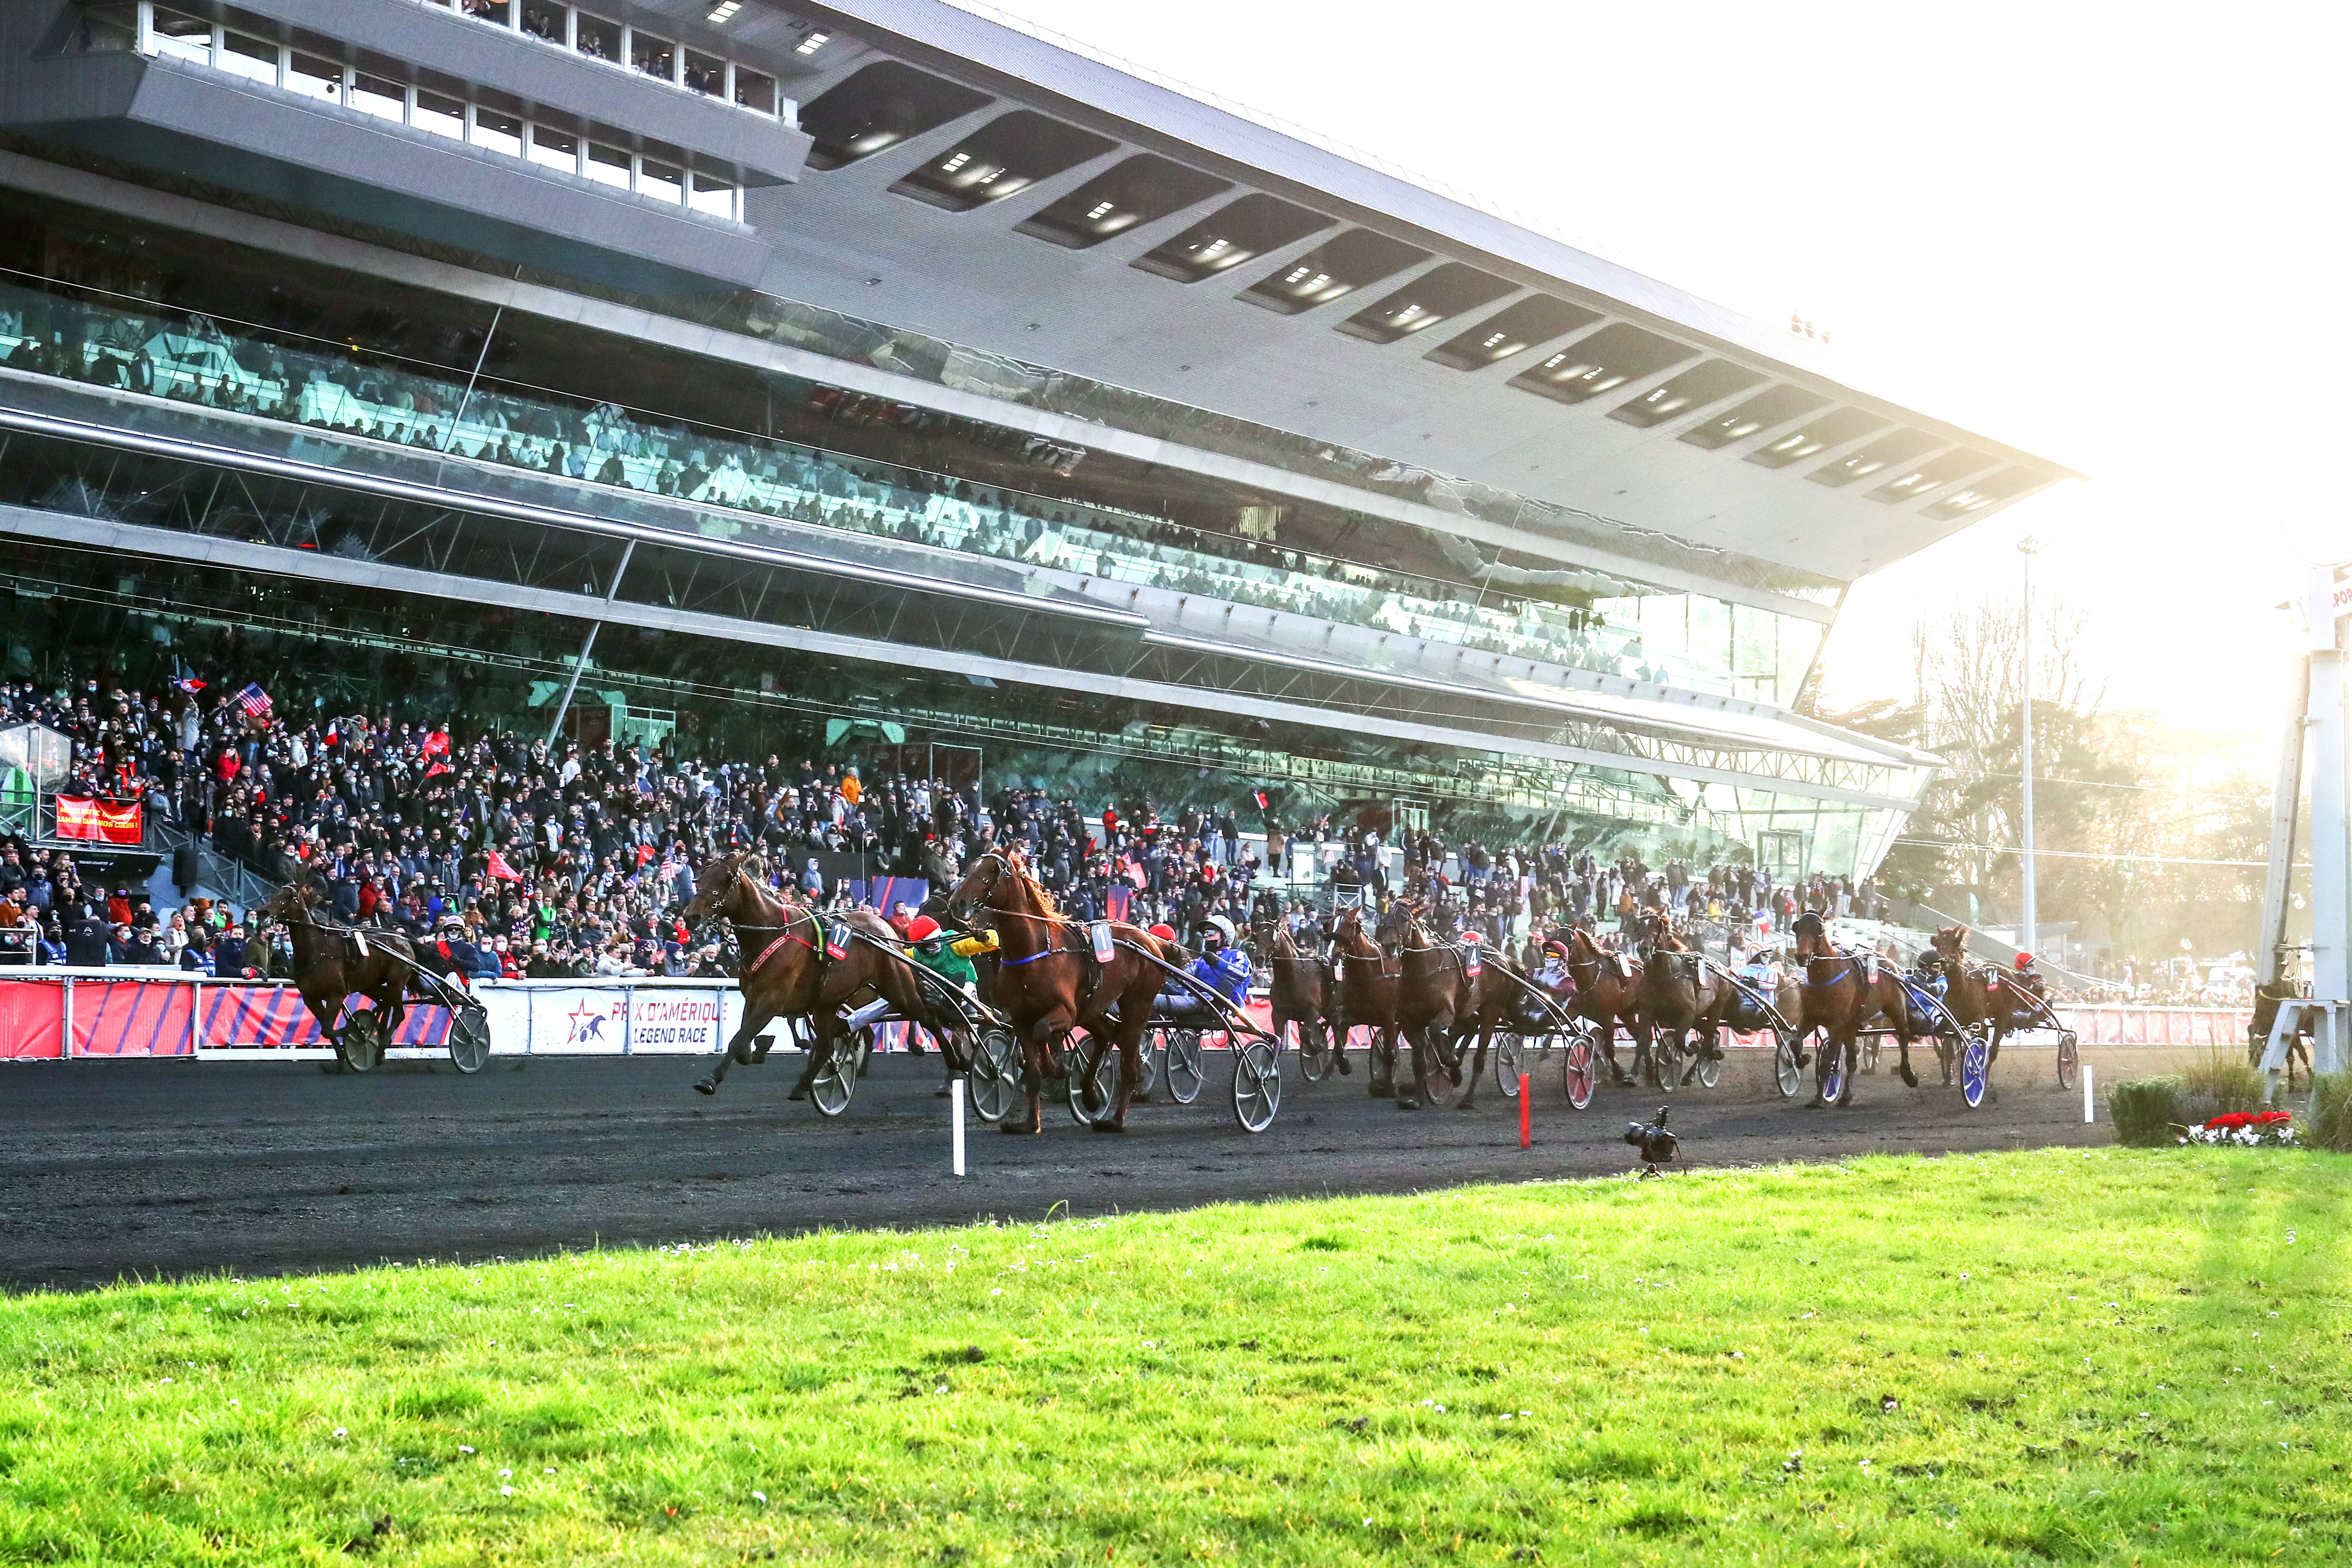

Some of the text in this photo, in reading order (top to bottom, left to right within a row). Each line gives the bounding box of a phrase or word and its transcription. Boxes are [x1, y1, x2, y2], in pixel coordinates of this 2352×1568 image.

[834, 923, 851, 948] 17
[1096, 925, 1107, 951] 1
[1470, 948, 1478, 967] 4
[1870, 957, 1876, 975] 9
[1988, 970, 1998, 984] 14
[634, 1028, 707, 1043] LEGEND RACE
